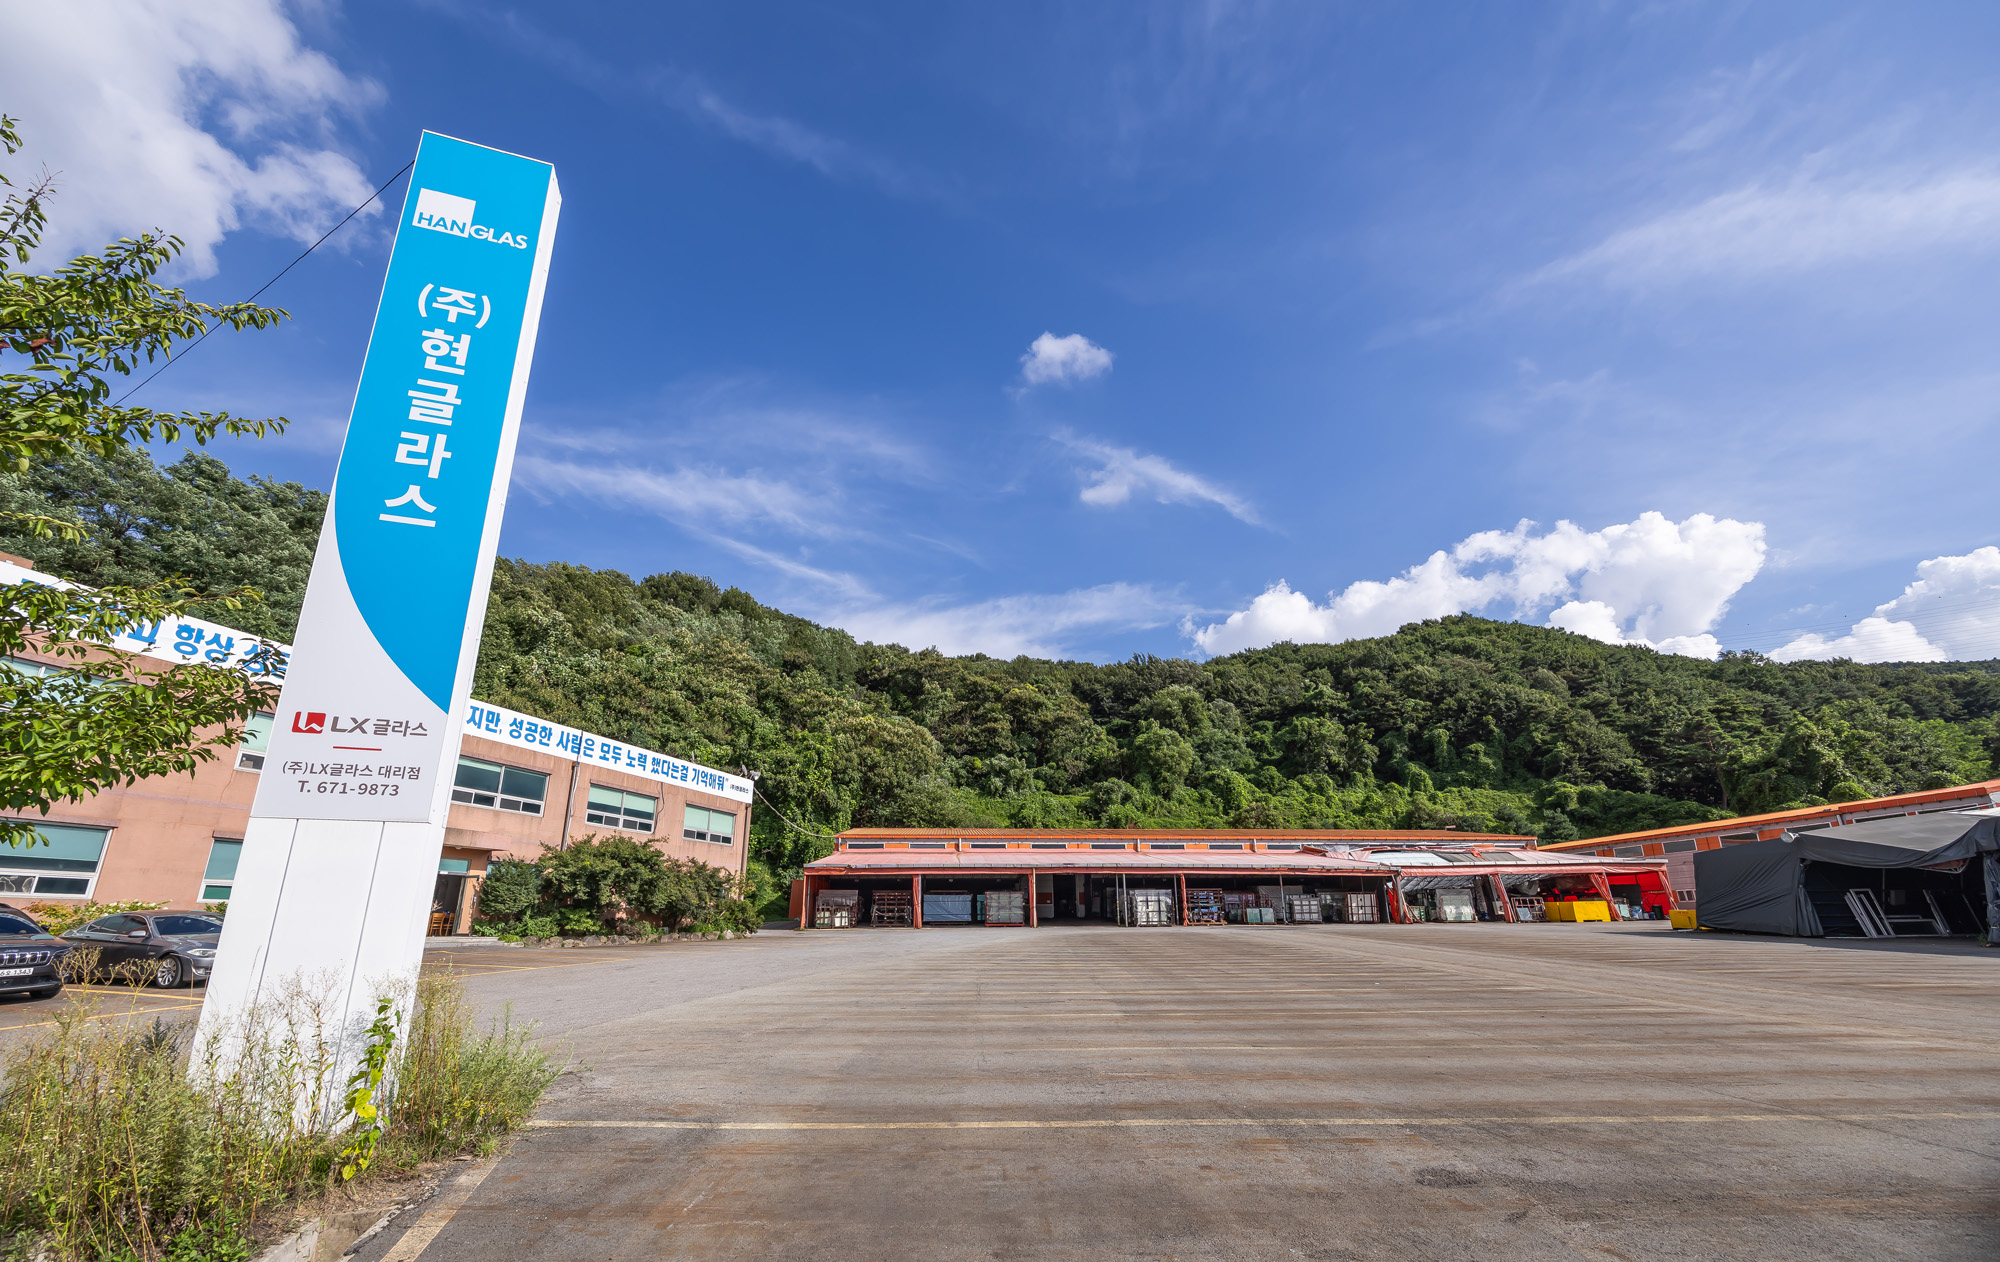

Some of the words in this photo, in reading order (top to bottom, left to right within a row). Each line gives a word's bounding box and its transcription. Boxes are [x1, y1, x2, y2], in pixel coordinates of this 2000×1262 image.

[417, 212, 529, 249] HANGLAS
[173, 624, 235, 663] 항상
[509, 717, 553, 747] 성공한
[556, 730, 595, 758] 사람은
[599, 742, 622, 765] 모두
[626, 749, 648, 771] 노력
[651, 756, 689, 782] 했다는걸
[282, 760, 374, 778] (주)LX글라스
[377, 765, 421, 780] 대리점
[297, 780, 311, 793] T.
[317, 781, 400, 796] 671-9873
